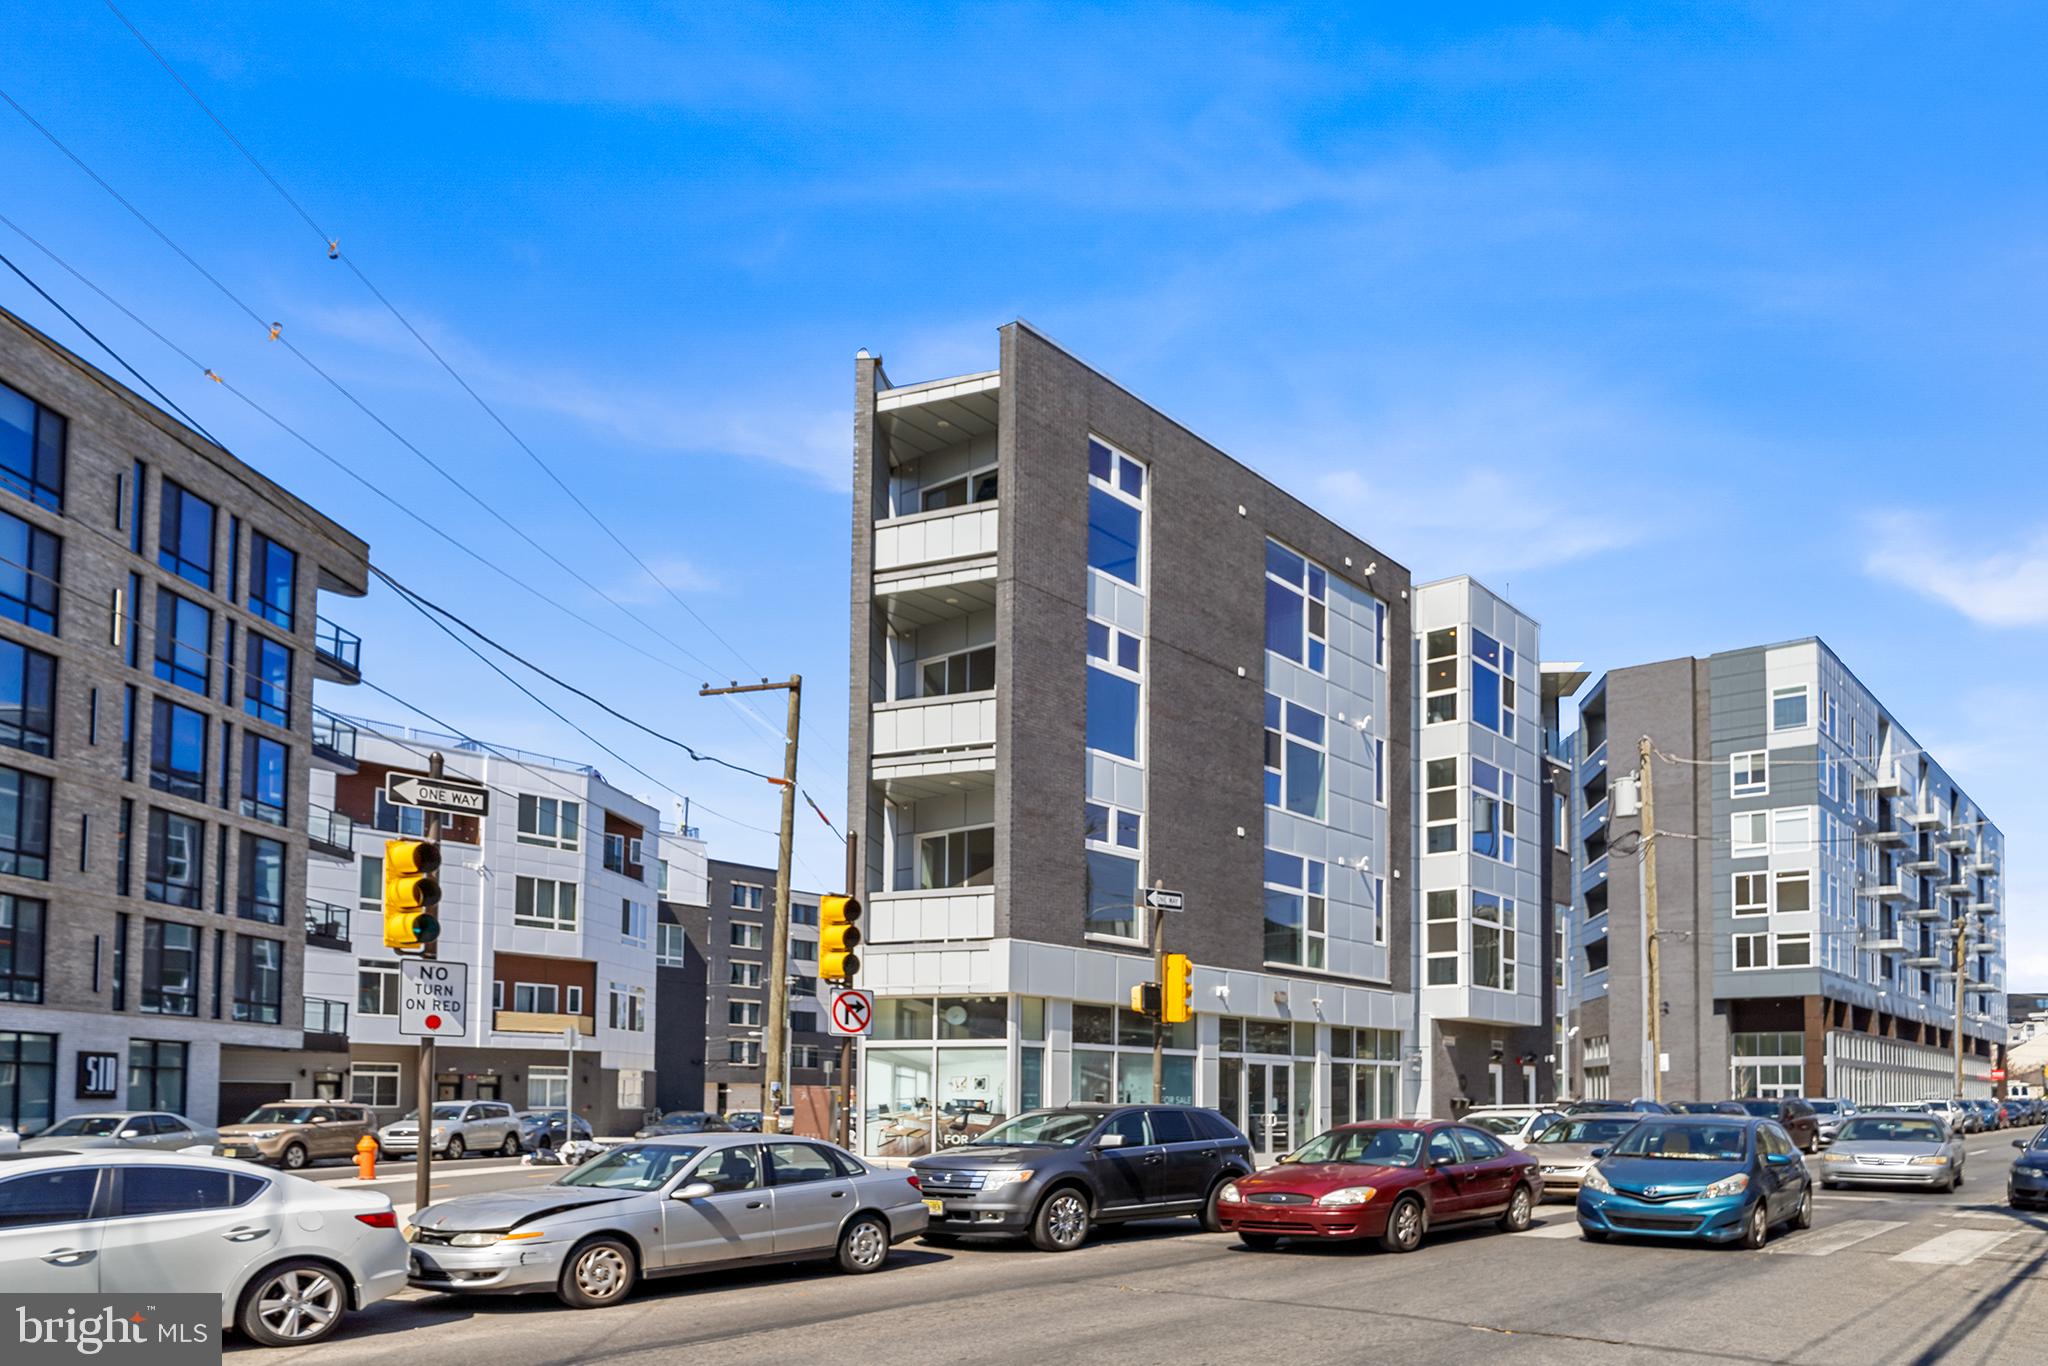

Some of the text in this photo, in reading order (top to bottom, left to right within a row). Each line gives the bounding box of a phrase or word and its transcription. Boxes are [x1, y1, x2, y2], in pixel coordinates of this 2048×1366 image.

[419, 787, 479, 806] ONE WAY
[420, 966, 448, 980] NO
[415, 983, 453, 997] TURN
[406, 998, 461, 1012] ON RED
[1175, 1096, 1191, 1105] SALE
[944, 1134, 969, 1145] FOR
